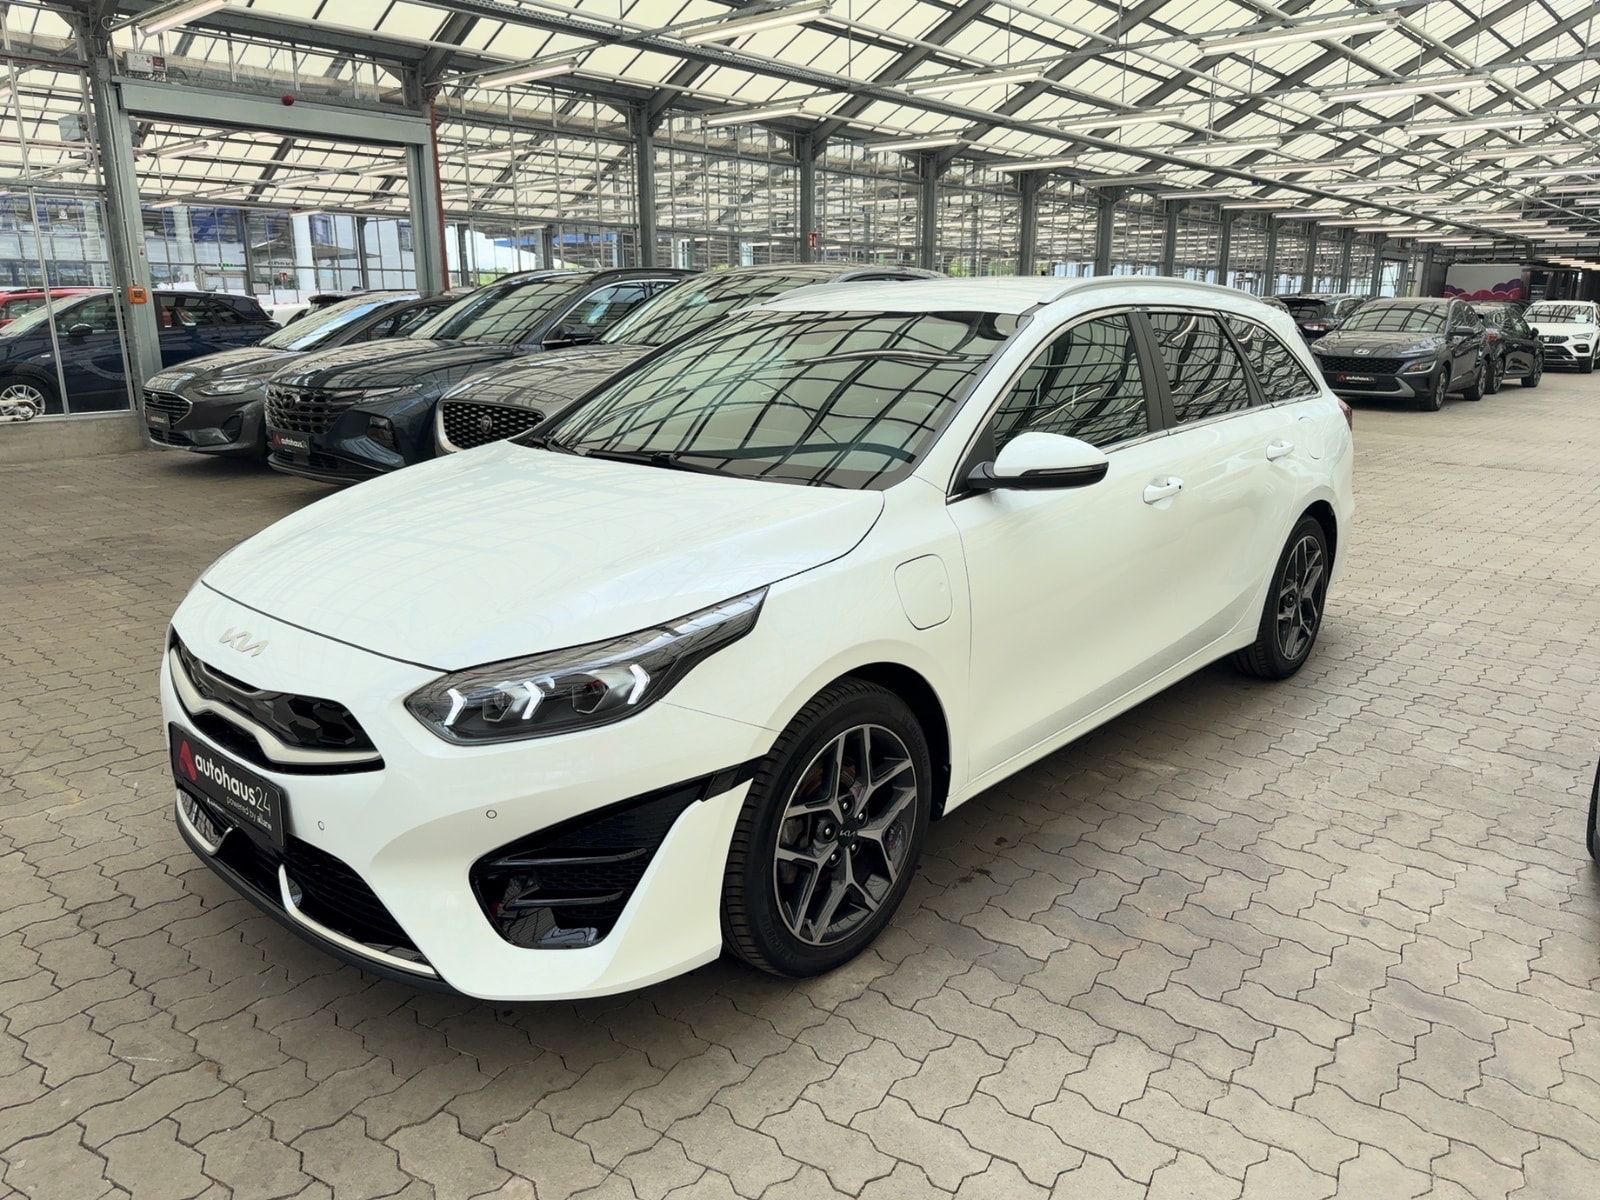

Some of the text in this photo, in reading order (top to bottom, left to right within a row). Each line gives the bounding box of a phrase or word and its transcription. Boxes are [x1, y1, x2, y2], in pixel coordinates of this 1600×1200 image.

[195, 754, 271, 817] autohaus24
[226, 796, 249, 815] powered
[250, 809, 256, 822] by
